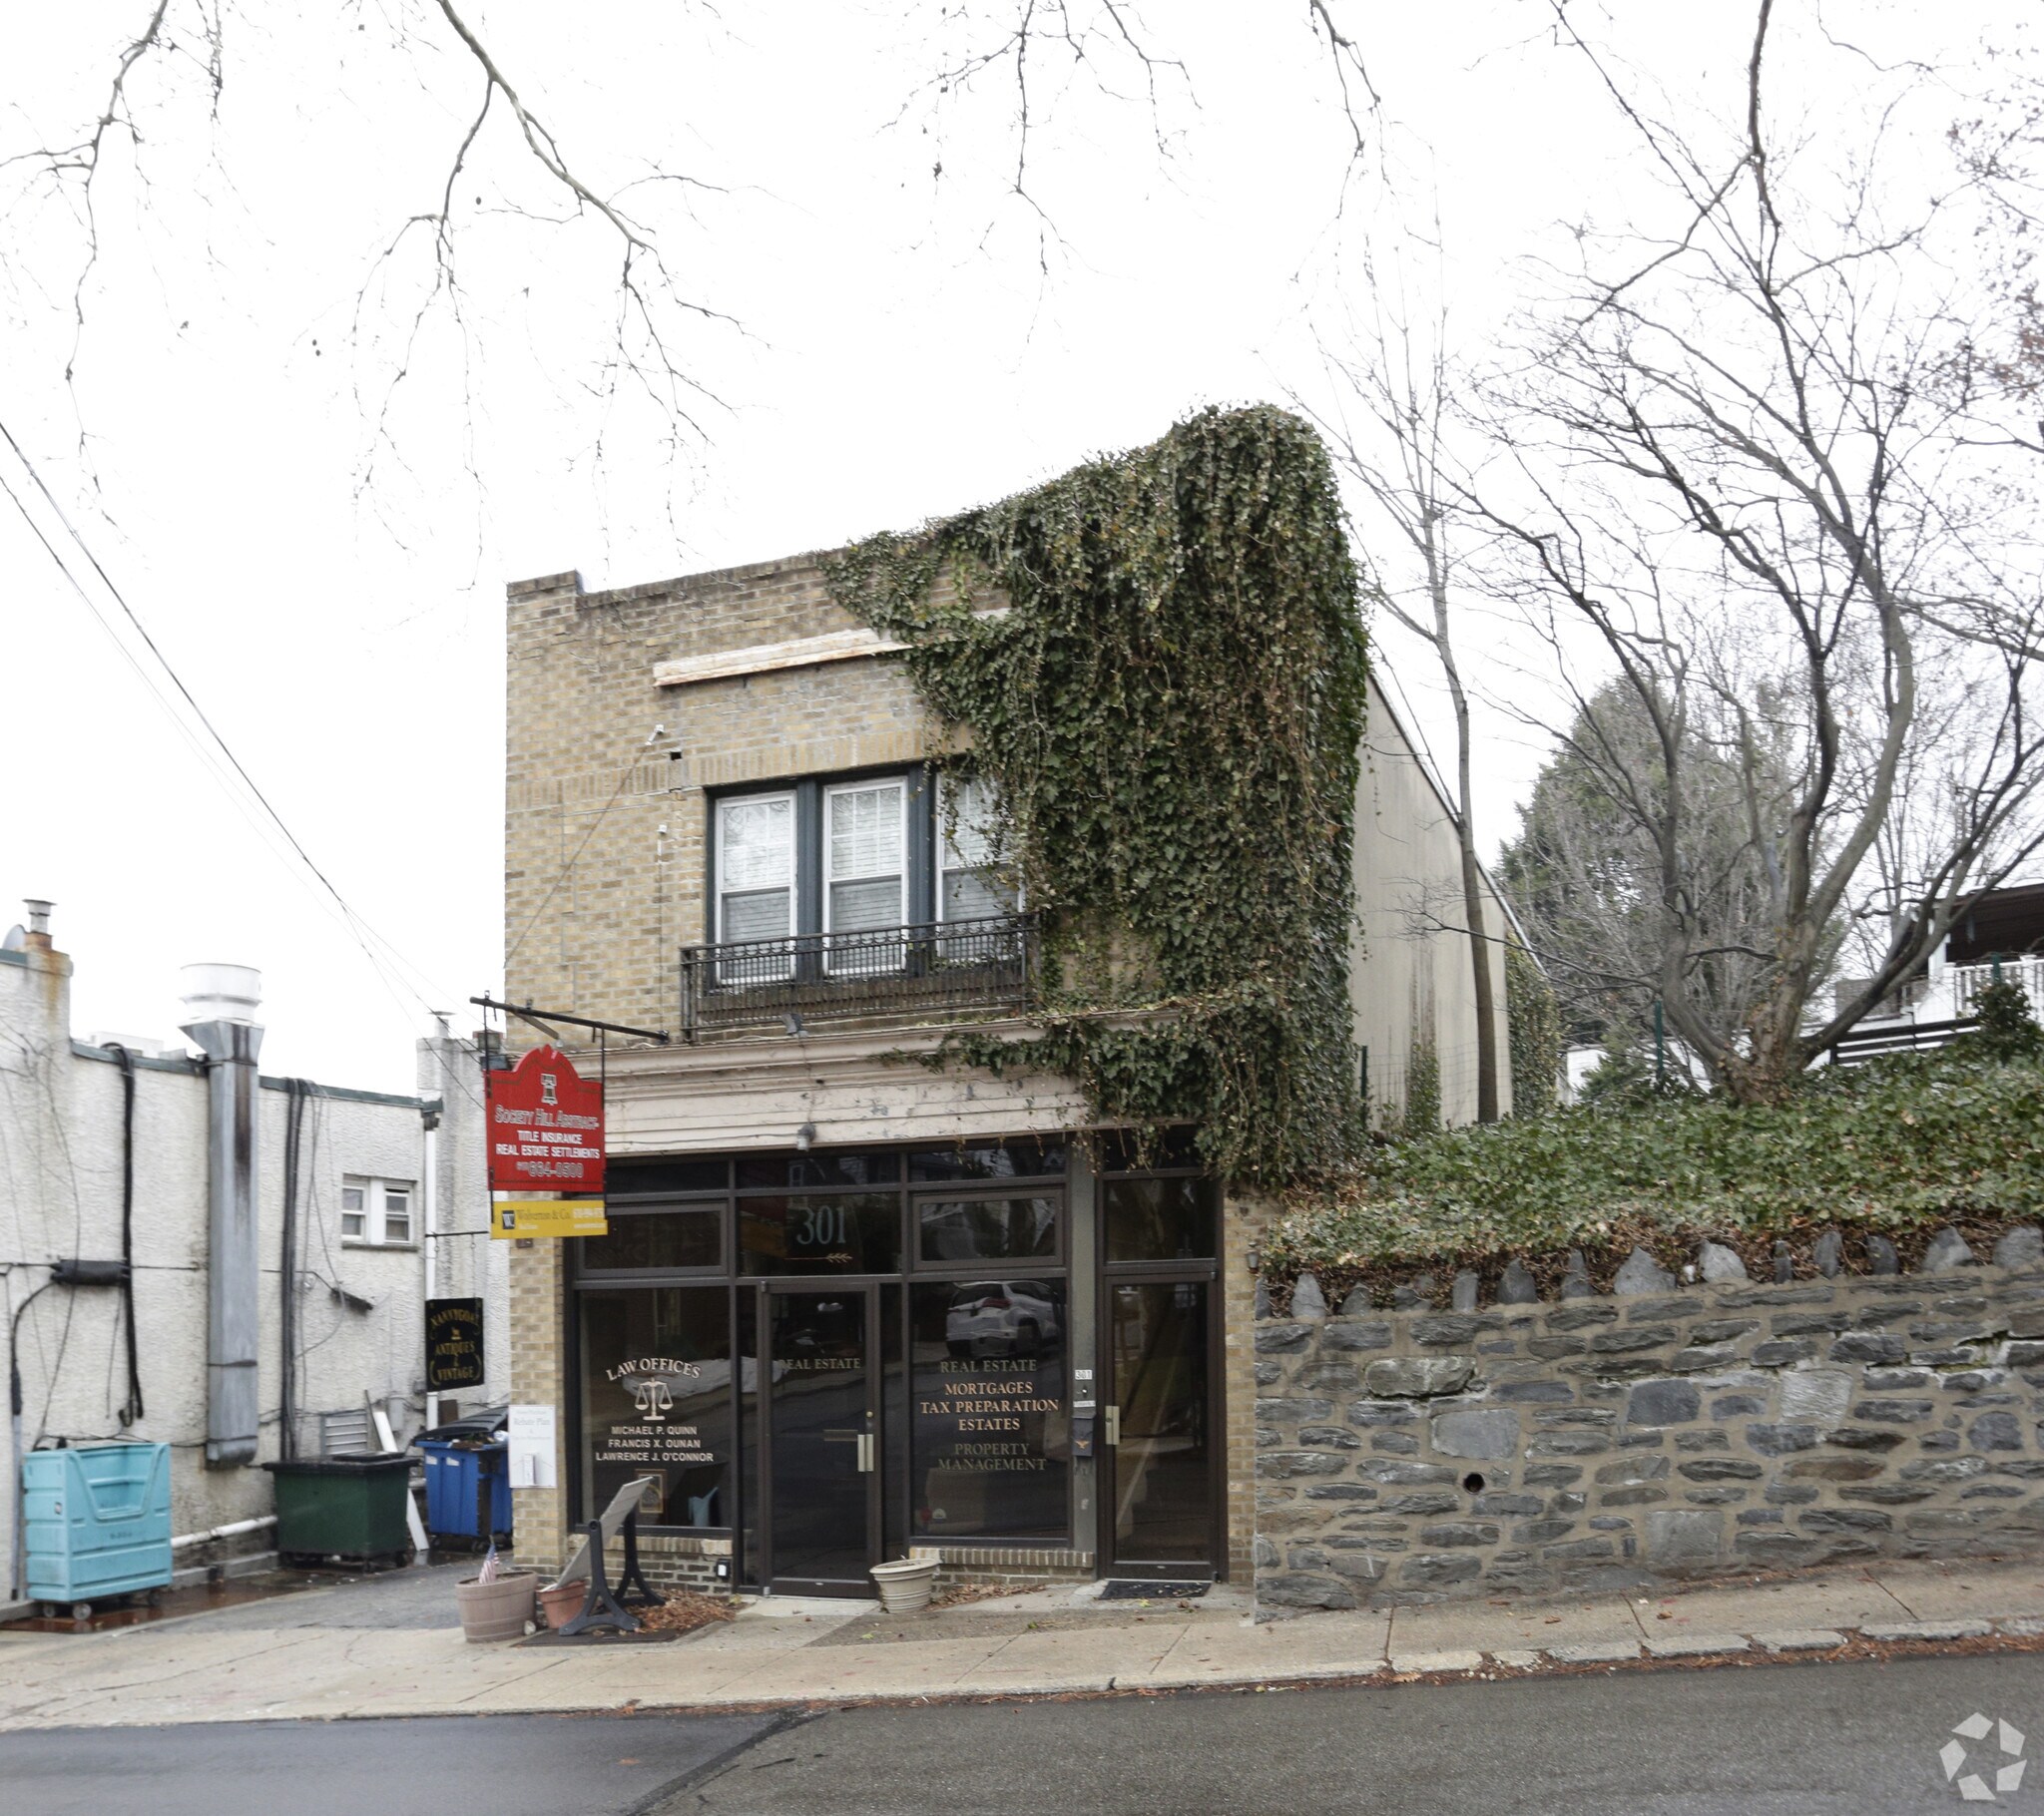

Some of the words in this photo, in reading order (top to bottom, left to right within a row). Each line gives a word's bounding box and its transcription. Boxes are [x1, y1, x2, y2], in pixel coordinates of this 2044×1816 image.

[517, 1130, 540, 1142] TITLE
[541, 1132, 583, 1144] INSURANCE
[495, 1143, 519, 1155] REAL
[521, 1144, 549, 1156] ESTATE
[551, 1146, 601, 1159] SETTLEMENTS
[796, 1205, 846, 1245] 301
[436, 1341, 475, 1356] ANTIQUES
[606, 1360, 637, 1381] LAW
[640, 1358, 701, 1379] OFFICES
[778, 1358, 810, 1370] REAL
[814, 1357, 861, 1370] ESTATE
[940, 1360, 979, 1374] REAL
[983, 1359, 1037, 1373] ESTATE
[437, 1366, 474, 1381] VINTAGE
[945, 1381, 1034, 1396] MORTGAGES
[920, 1401, 951, 1414] TAX
[955, 1399, 1060, 1413] PREPARATION
[611, 1426, 654, 1435] MICHAEL
[656, 1426, 665, 1435] P.
[667, 1426, 698, 1435] QUINN
[958, 1418, 1021, 1431] ESTATES
[608, 1439, 651, 1448] FRANCIS
[653, 1439, 664, 1448] X.
[954, 1443, 1030, 1456] PROPERTY
[595, 1452, 650, 1462] LAWRENCE
[652, 1452, 660, 1462] J.
[662, 1452, 715, 1462] O'CONNOR
[938, 1458, 1047, 1471] MANAGEMENT
